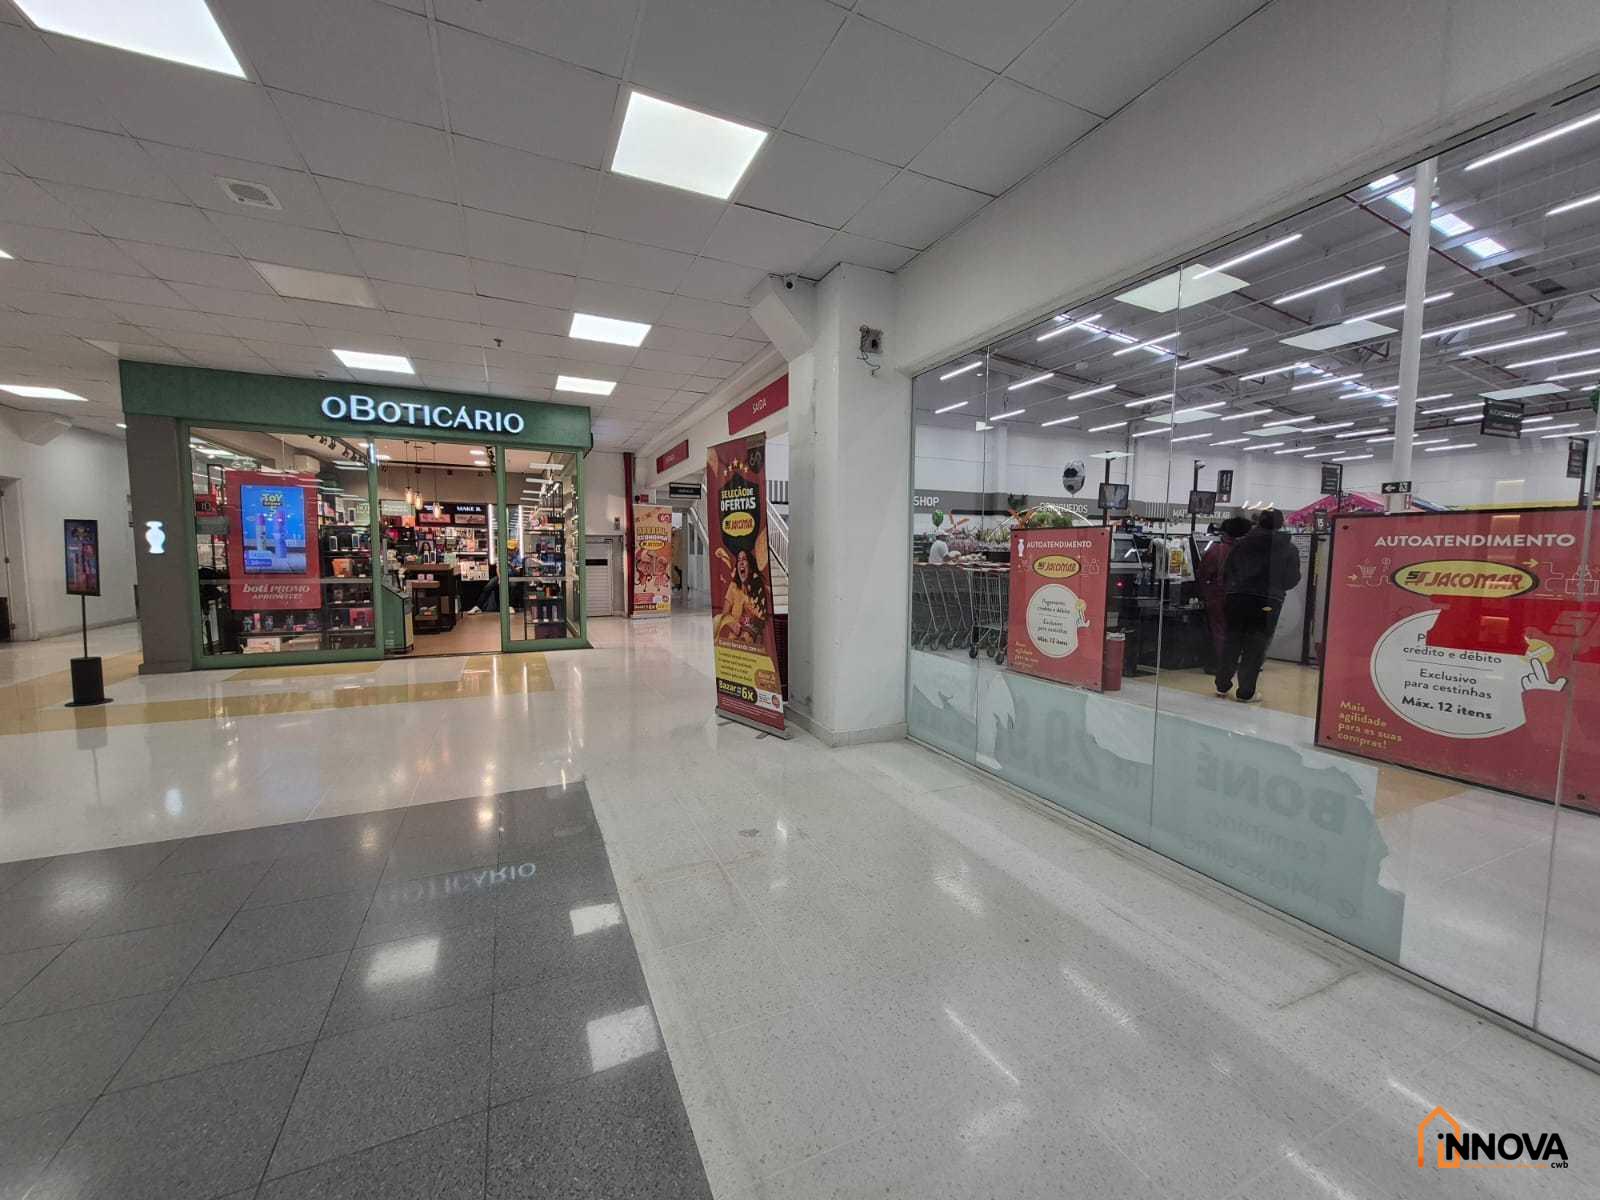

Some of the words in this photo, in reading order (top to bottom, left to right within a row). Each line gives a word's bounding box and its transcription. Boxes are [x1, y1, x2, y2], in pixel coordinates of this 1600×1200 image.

[721, 485, 747, 500] SELEÇÃO
[912, 495, 940, 506] SHOP
[720, 497, 756, 512] OFERTAS
[1026, 540, 1093, 549] AUTOATENDIMENTO
[1375, 533, 1577, 548] AUTOATENDIMENTO
[1424, 570, 1525, 591] JACOMAR
[1403, 645, 1444, 658] crédito
[1459, 651, 1502, 664] débito
[1419, 668, 1477, 686] Exclusivo
[741, 686, 754, 701] 6x
[1404, 679, 1429, 691] para
[1432, 682, 1492, 700] cestinhas
[1340, 700, 1366, 713] Mais
[1401, 695, 1434, 710] Máx.
[1438, 701, 1454, 714] 12
[1456, 703, 1492, 720] itens
[1339, 712, 1387, 728] agilidade
[1338, 722, 1362, 734] para
[1378, 731, 1402, 742] suas
[1337, 733, 1388, 750] compras!
